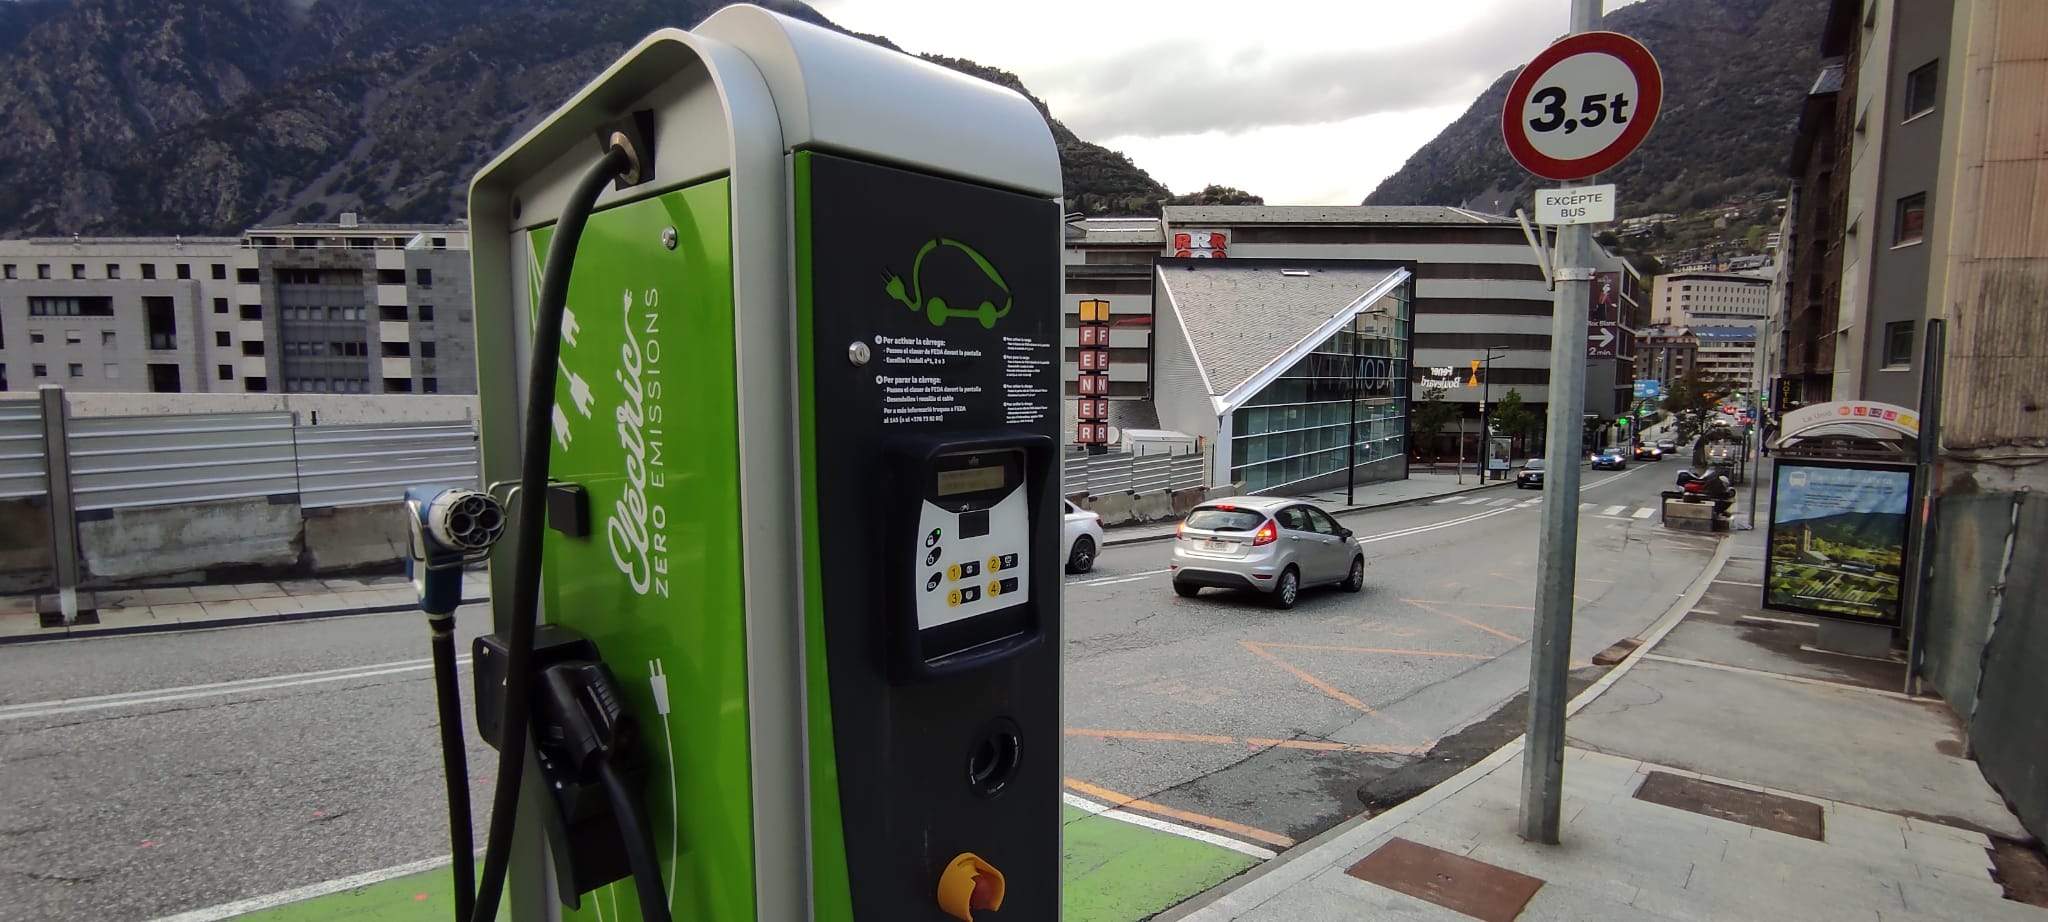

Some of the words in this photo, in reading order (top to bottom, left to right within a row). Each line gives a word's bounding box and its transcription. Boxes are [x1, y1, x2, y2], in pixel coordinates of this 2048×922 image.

[1529, 86, 1629, 135] 3,5t
[1546, 193, 1603, 206] EXCEPTE
[1560, 207, 1586, 218] BUS
[883, 336, 893, 344] Per
[894, 336, 915, 345] activar
[915, 337, 922, 345] la
[1589, 347, 1596, 355] 2
[645, 287, 664, 487] EMISSIONS
[894, 377, 911, 385] parar
[1082, 329, 1092, 439] FENER
[1098, 330, 1106, 439] FENER
[651, 504, 669, 599] ZERO
